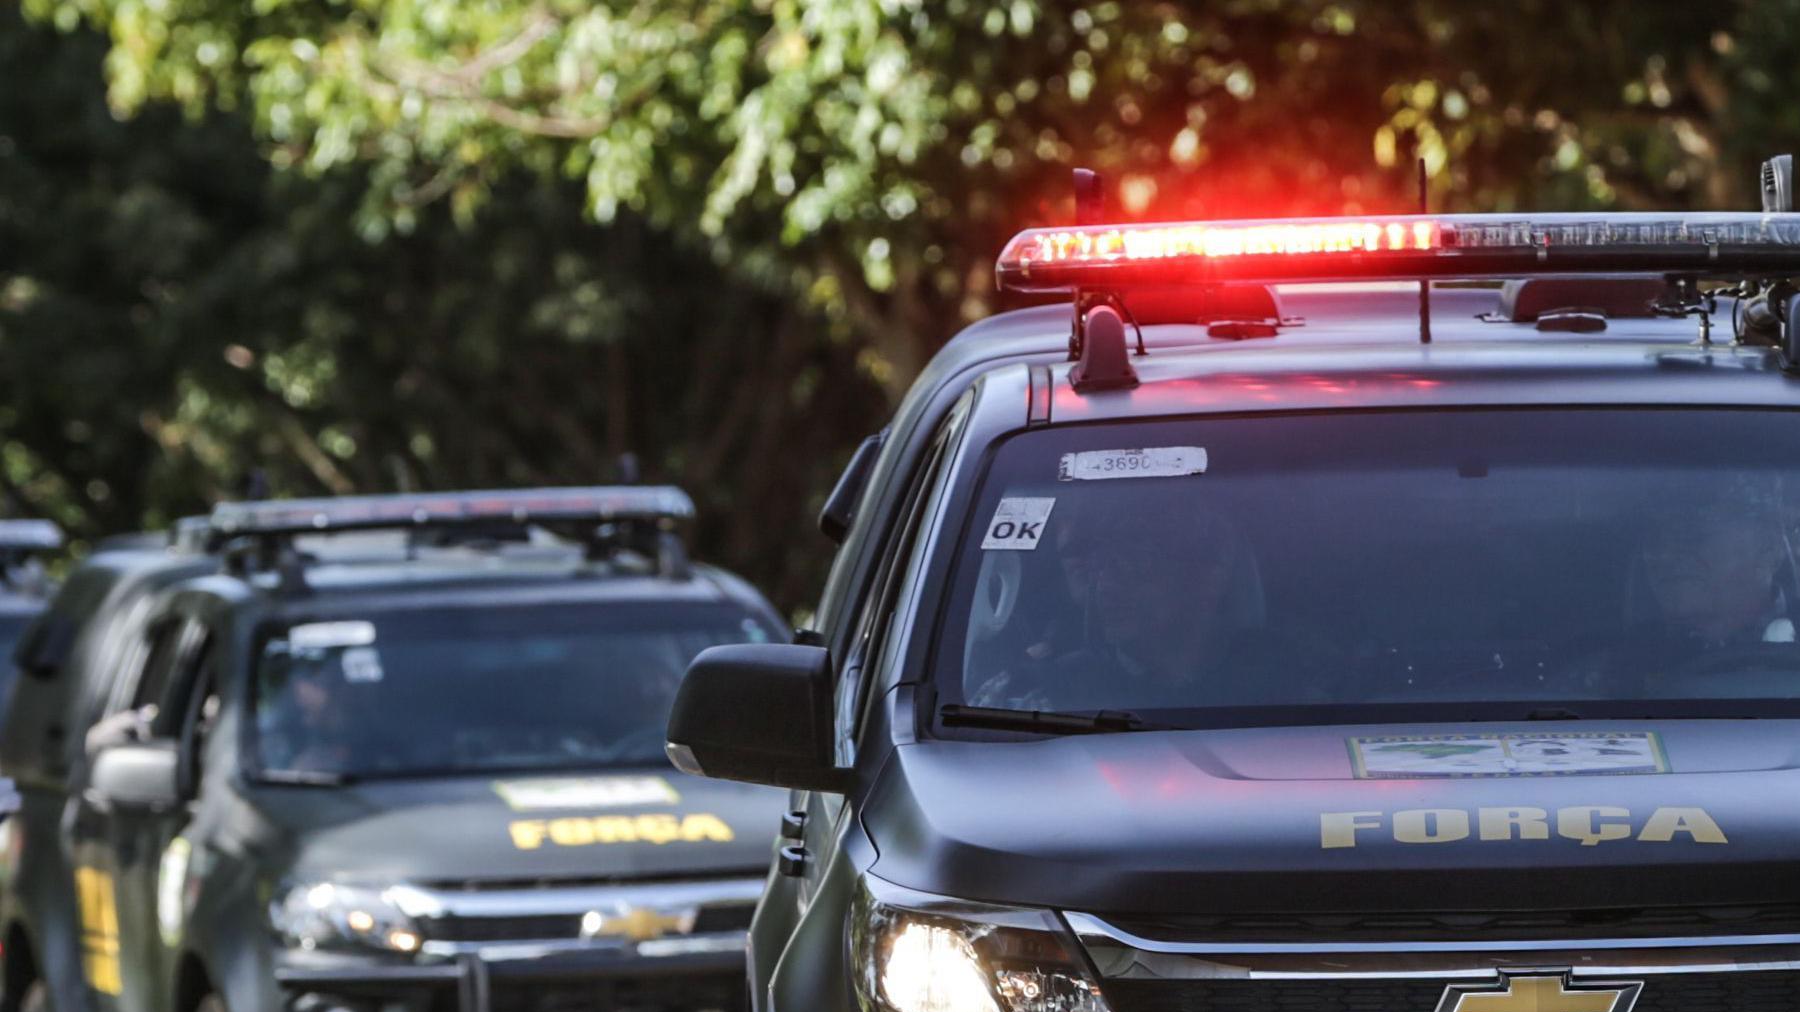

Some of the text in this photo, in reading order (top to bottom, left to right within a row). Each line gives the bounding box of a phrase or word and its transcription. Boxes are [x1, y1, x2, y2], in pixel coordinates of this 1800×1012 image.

[992, 522, 1042, 540] OK
[508, 813, 735, 849] FORÇA
[1320, 806, 1729, 848] FORÇA
